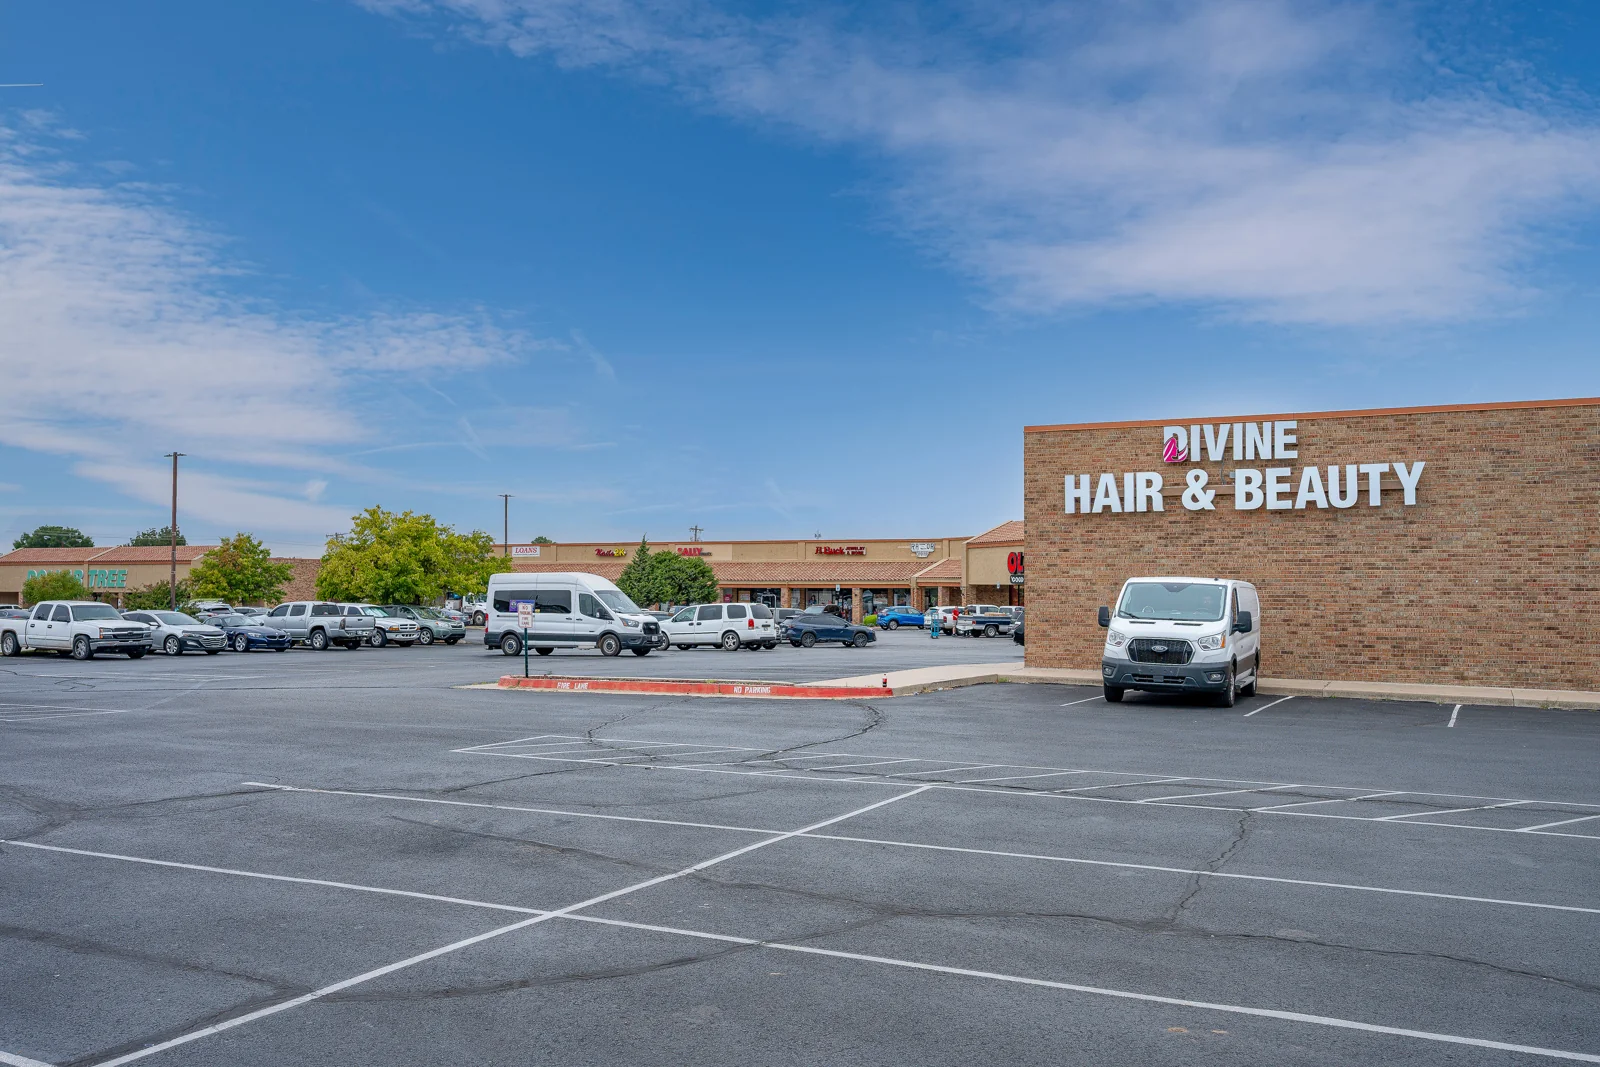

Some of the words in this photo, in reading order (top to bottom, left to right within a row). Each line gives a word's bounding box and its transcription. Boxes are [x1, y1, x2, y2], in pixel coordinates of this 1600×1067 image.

[1163, 420, 1298, 462] DIVINE
[1064, 471, 1165, 514] HAIR
[1181, 468, 1216, 511] &
[1235, 461, 1426, 510] BEAUTY
[677, 547, 703, 556] SALLY
[88, 569, 129, 588] TREE
[574, 682, 589, 690] LANE
[733, 686, 742, 694] NO
[744, 686, 771, 694] PARKING
